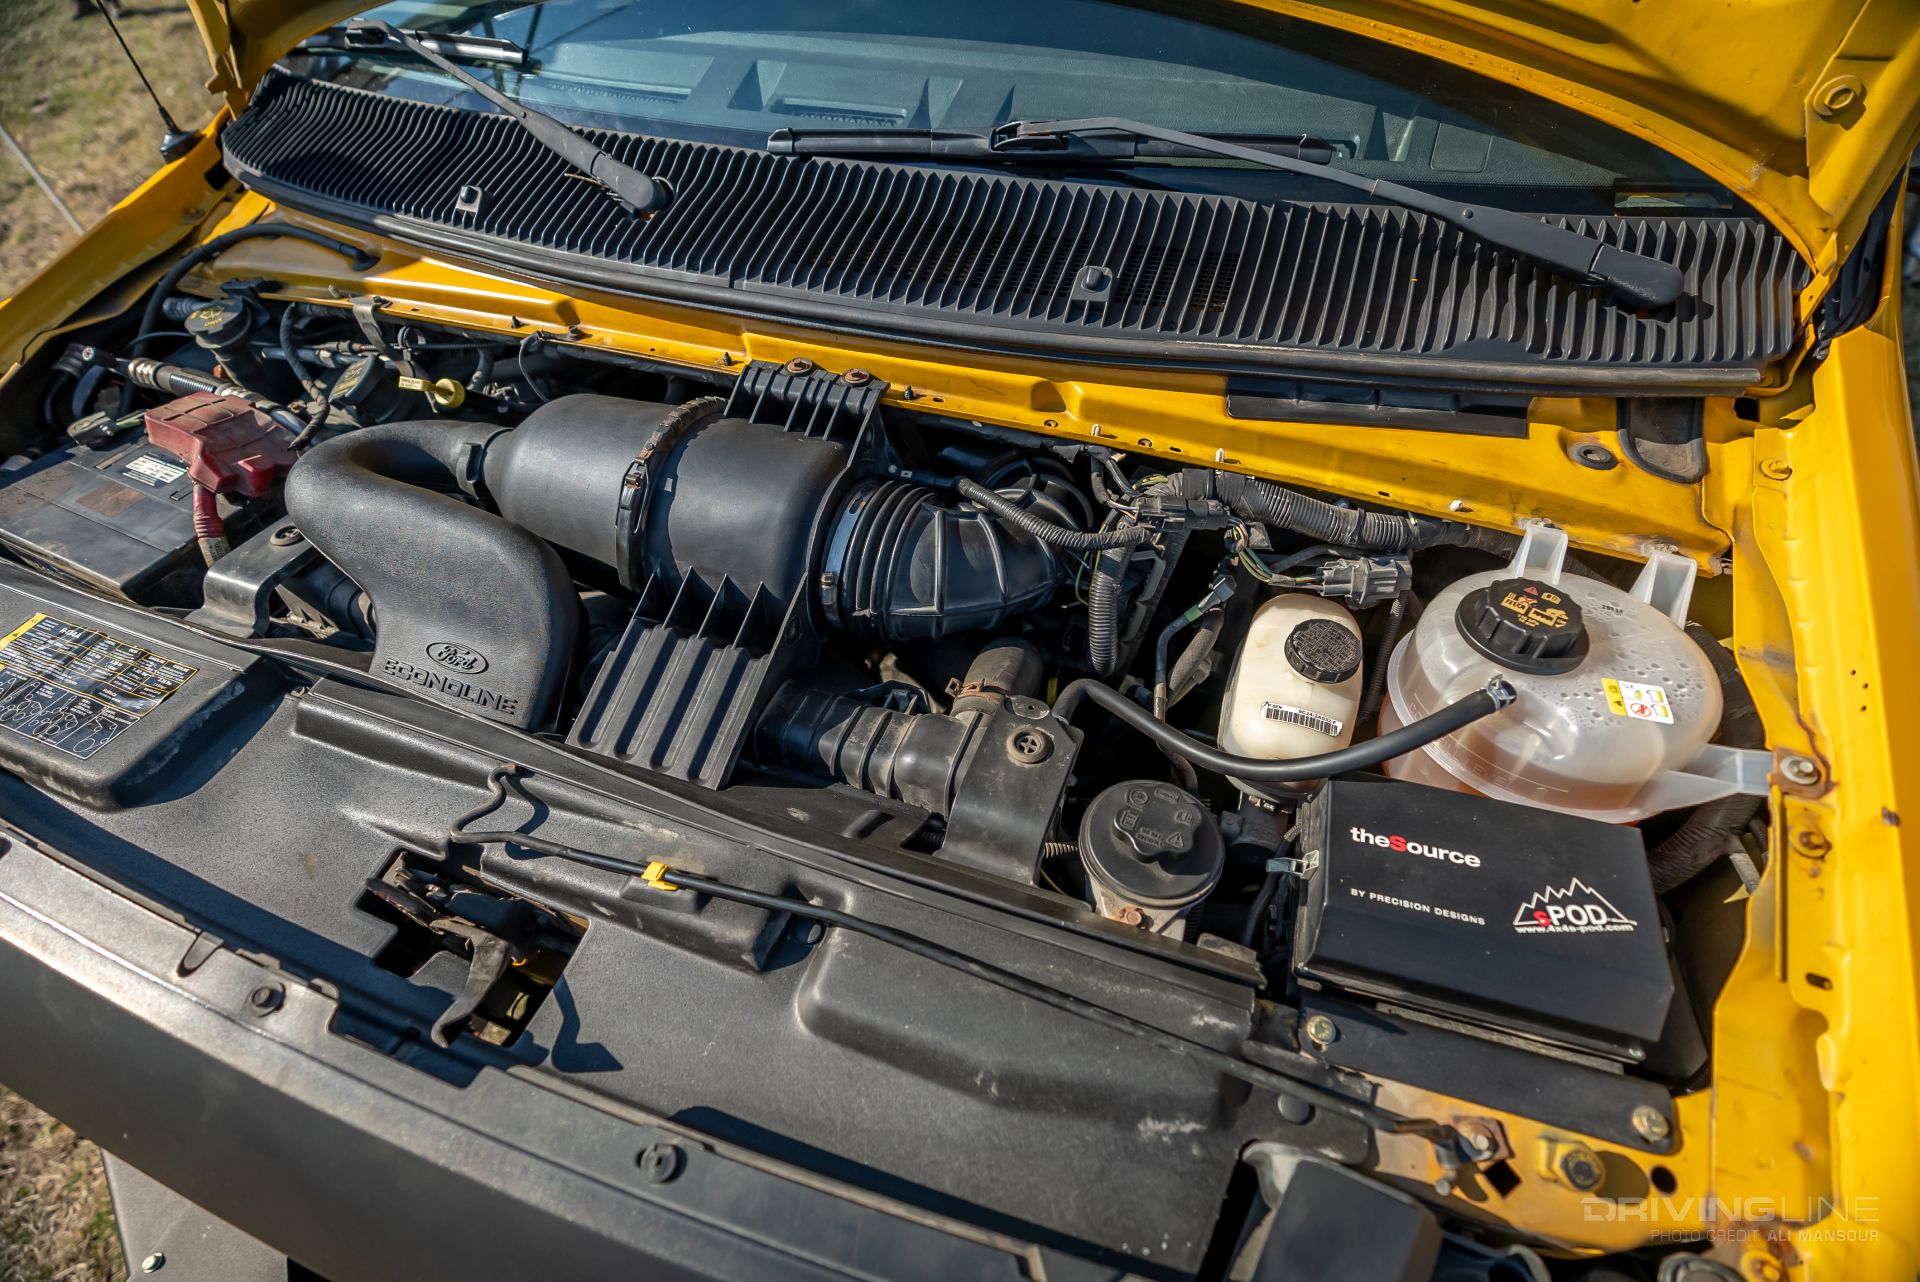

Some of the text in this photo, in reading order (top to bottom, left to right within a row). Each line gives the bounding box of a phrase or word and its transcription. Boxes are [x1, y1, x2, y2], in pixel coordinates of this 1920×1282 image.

[438, 645, 478, 671] Ford
[382, 658, 518, 715] ECONOLINE
[1350, 826, 1481, 868] theSource
[1350, 888, 1486, 926] BY PRECISION DESIGNS
[1533, 904, 1608, 927] sPOD
